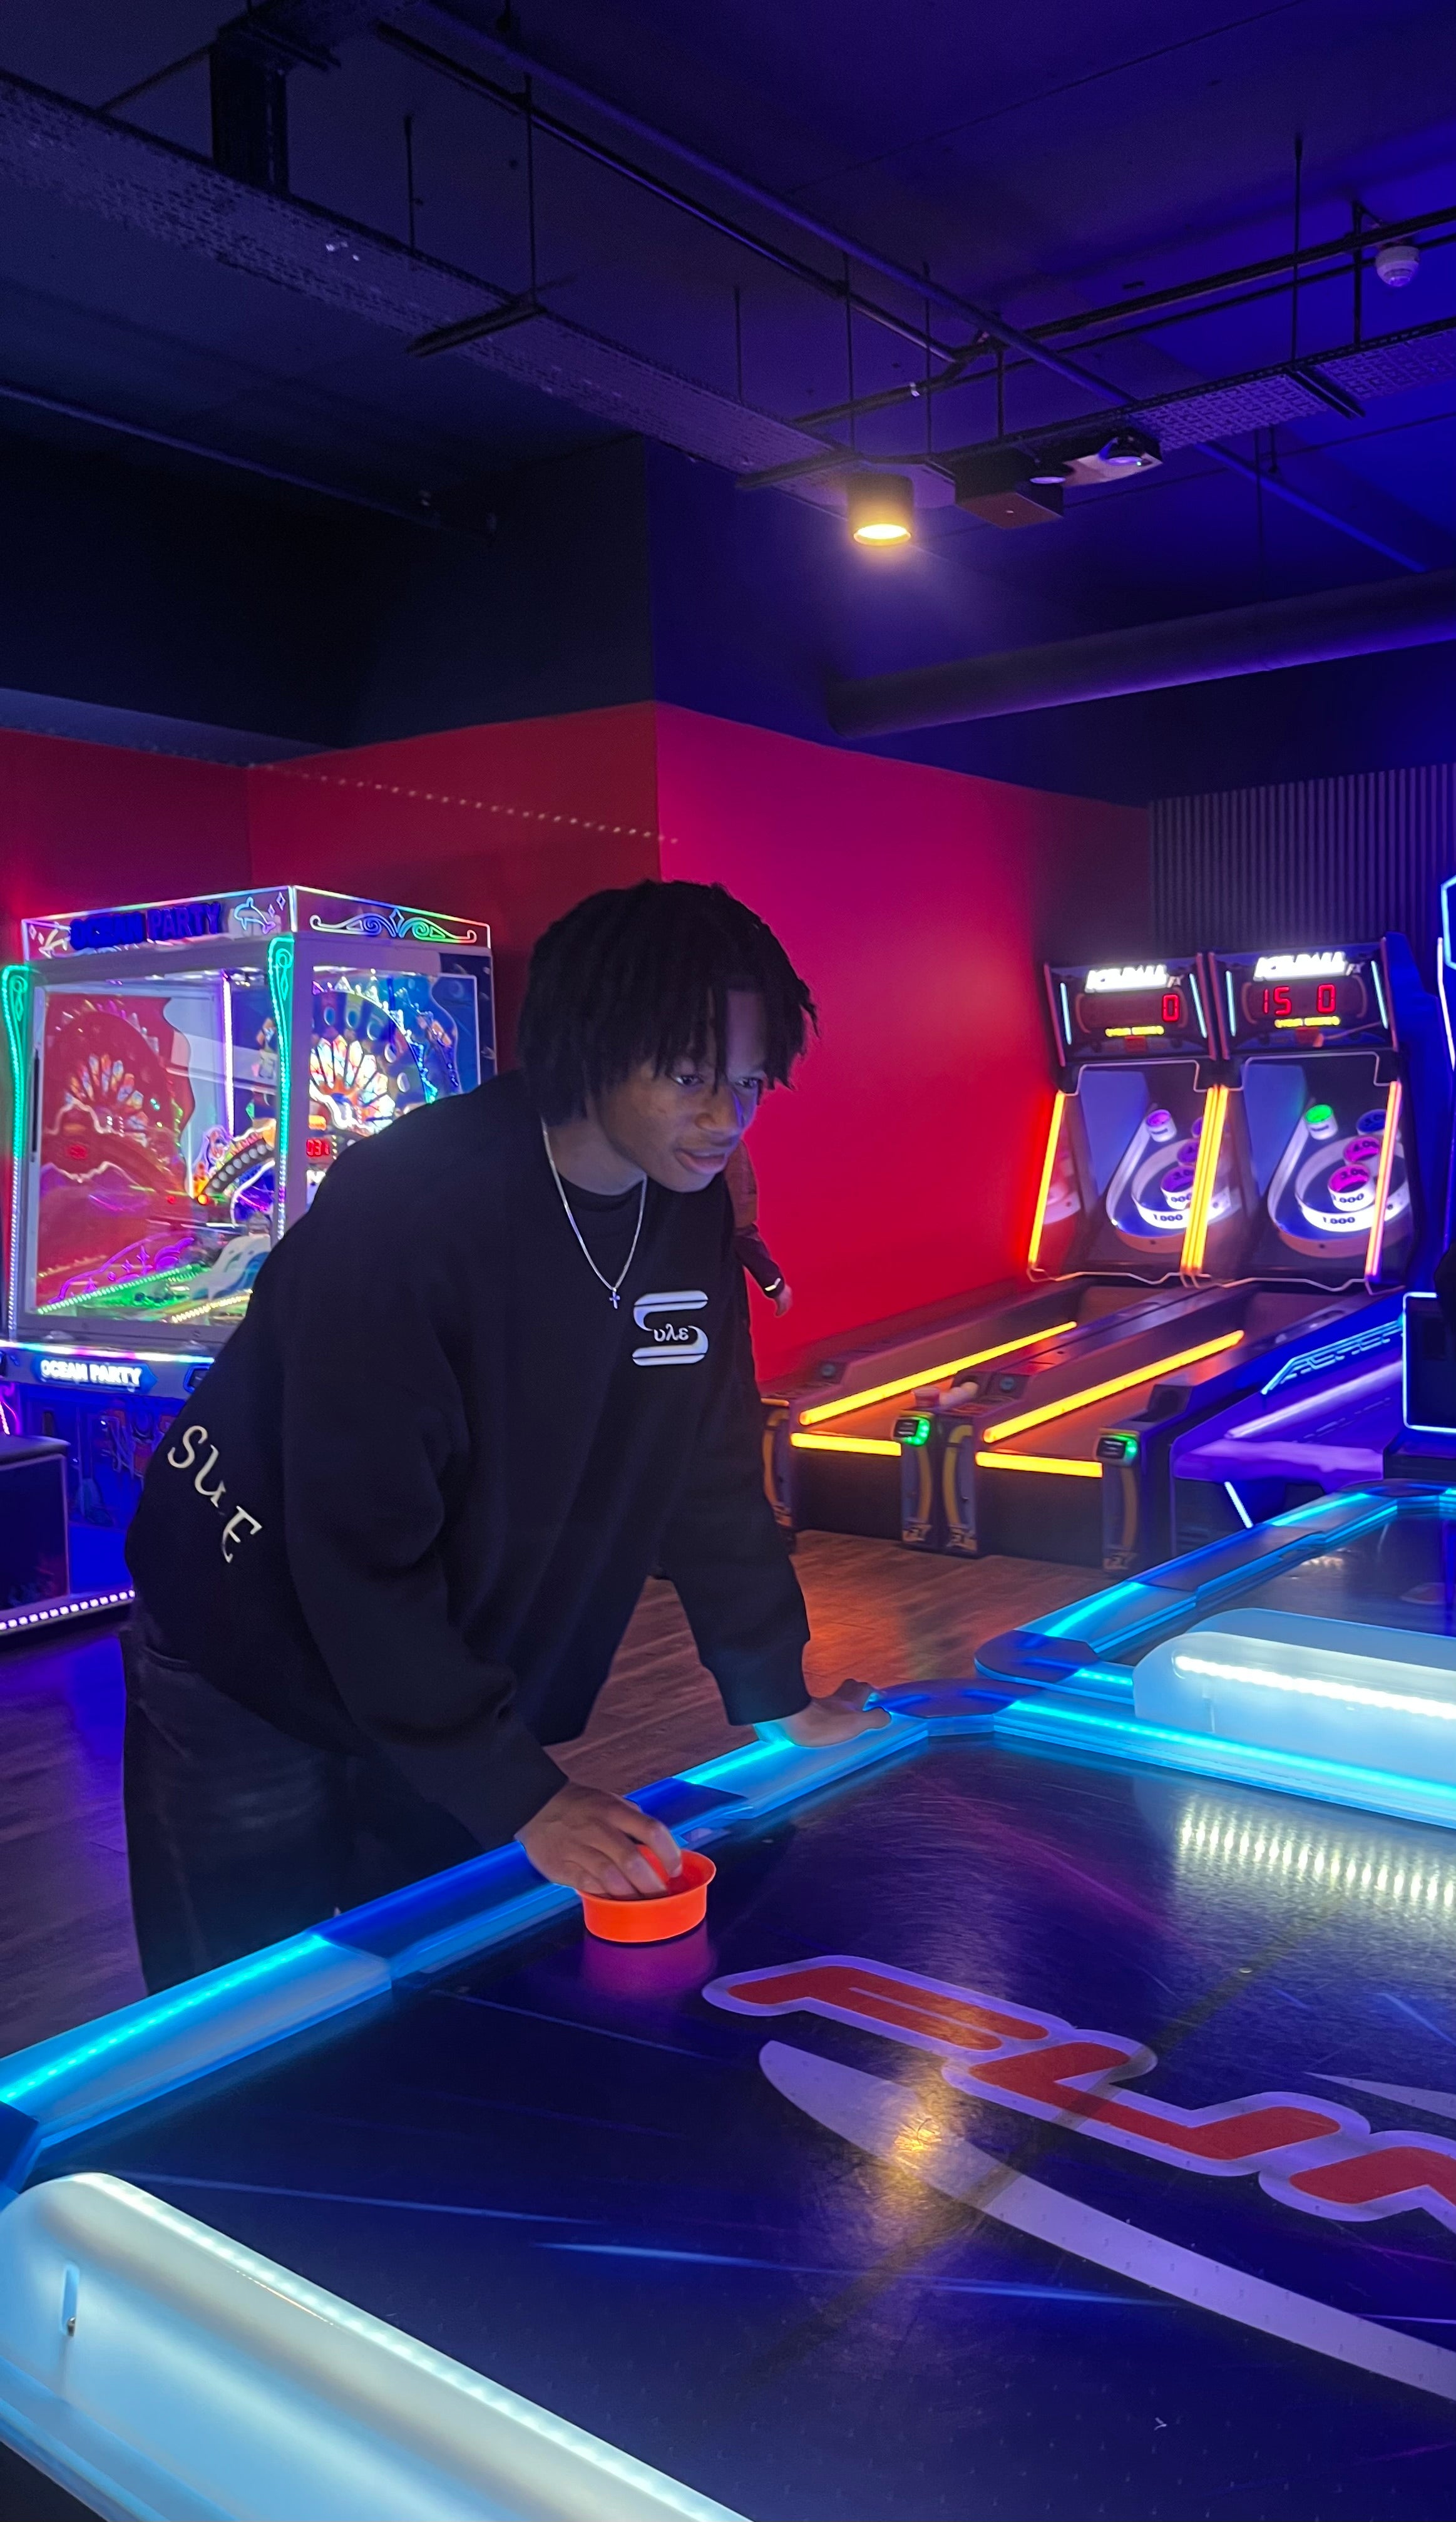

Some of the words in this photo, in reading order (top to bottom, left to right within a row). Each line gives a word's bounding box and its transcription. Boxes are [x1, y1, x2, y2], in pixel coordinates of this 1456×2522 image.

[148, 902, 222, 940] PARTY
[1162, 993, 1180, 1022] 0
[1316, 984, 1336, 1013] 0
[41, 1360, 88, 1382] OCEAN
[89, 1363, 141, 1387] PARTY
